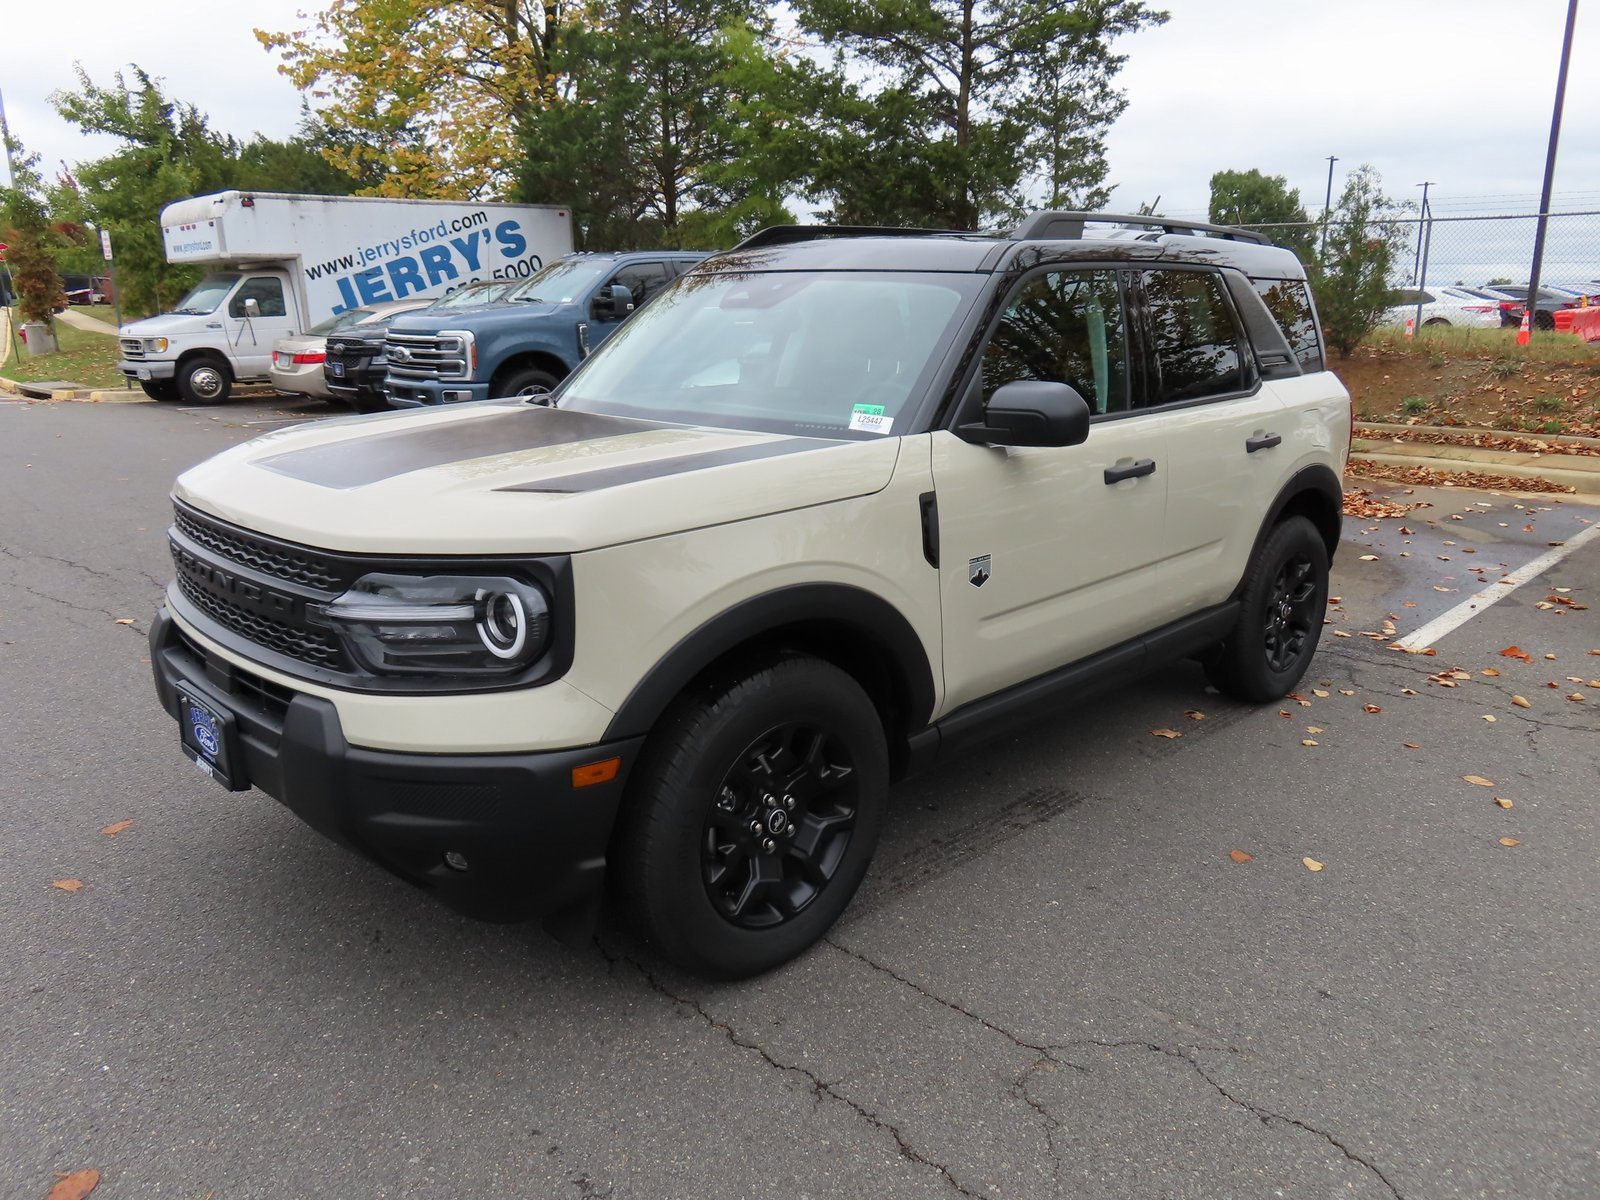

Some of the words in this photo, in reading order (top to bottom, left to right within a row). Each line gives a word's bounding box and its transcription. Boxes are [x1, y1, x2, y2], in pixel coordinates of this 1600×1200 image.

[305, 210, 489, 281] www.jerrysford.com
[332, 220, 527, 315] JERRY'S
[858, 415, 883, 424] L25447
